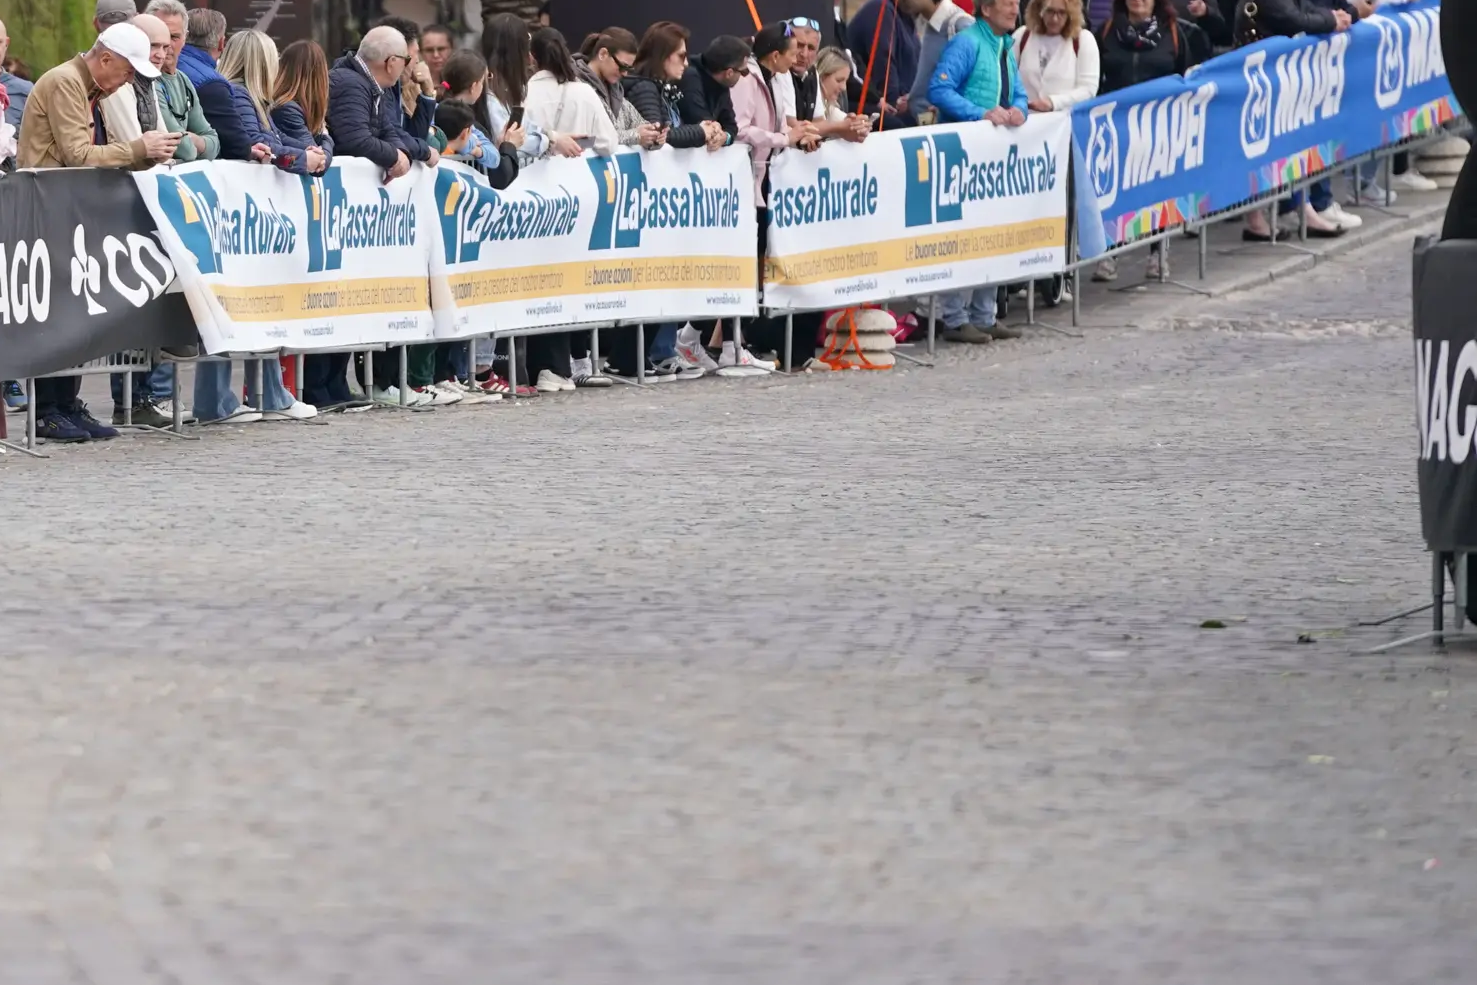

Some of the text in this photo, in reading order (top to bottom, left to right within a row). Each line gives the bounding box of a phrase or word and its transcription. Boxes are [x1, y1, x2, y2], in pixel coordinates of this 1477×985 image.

[1274, 33, 1351, 137] MAPEI
[1398, 6, 1446, 89] MA
[1123, 81, 1218, 191] MAPEI
[593, 264, 612, 285] buone
[613, 261, 633, 284] azioni
[824, 254, 845, 273] nostro
[846, 249, 878, 270] territorio
[914, 238, 936, 259] buone
[938, 234, 959, 257] azioni
[1416, 338, 1477, 465] NAG
